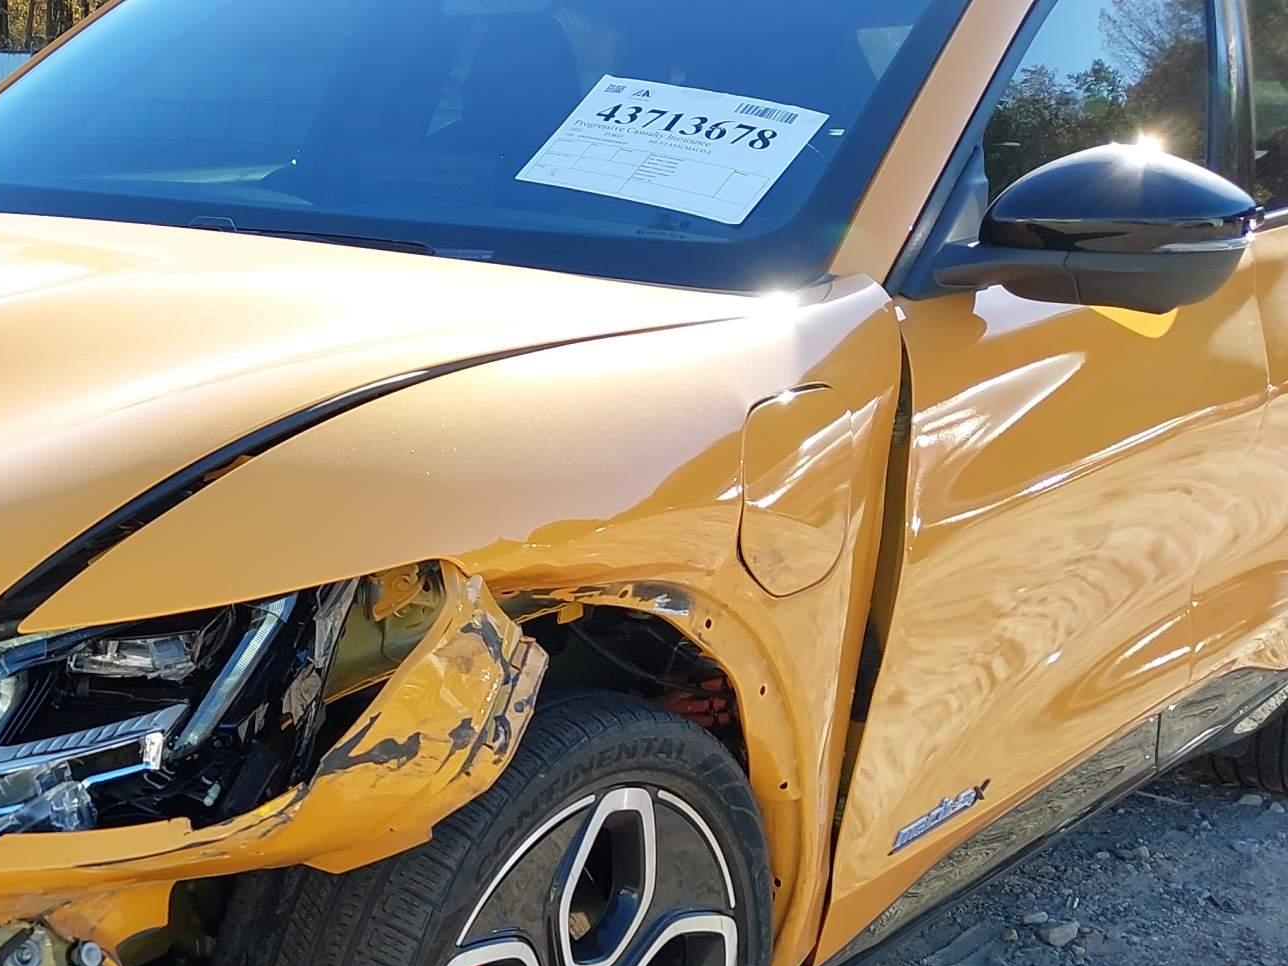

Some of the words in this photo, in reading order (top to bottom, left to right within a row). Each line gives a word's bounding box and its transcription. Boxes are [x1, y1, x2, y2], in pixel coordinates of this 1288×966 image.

[595, 103, 778, 150] 43713678
[626, 126, 667, 140] Casualty
[476, 737, 690, 882] CONTINENTAL
